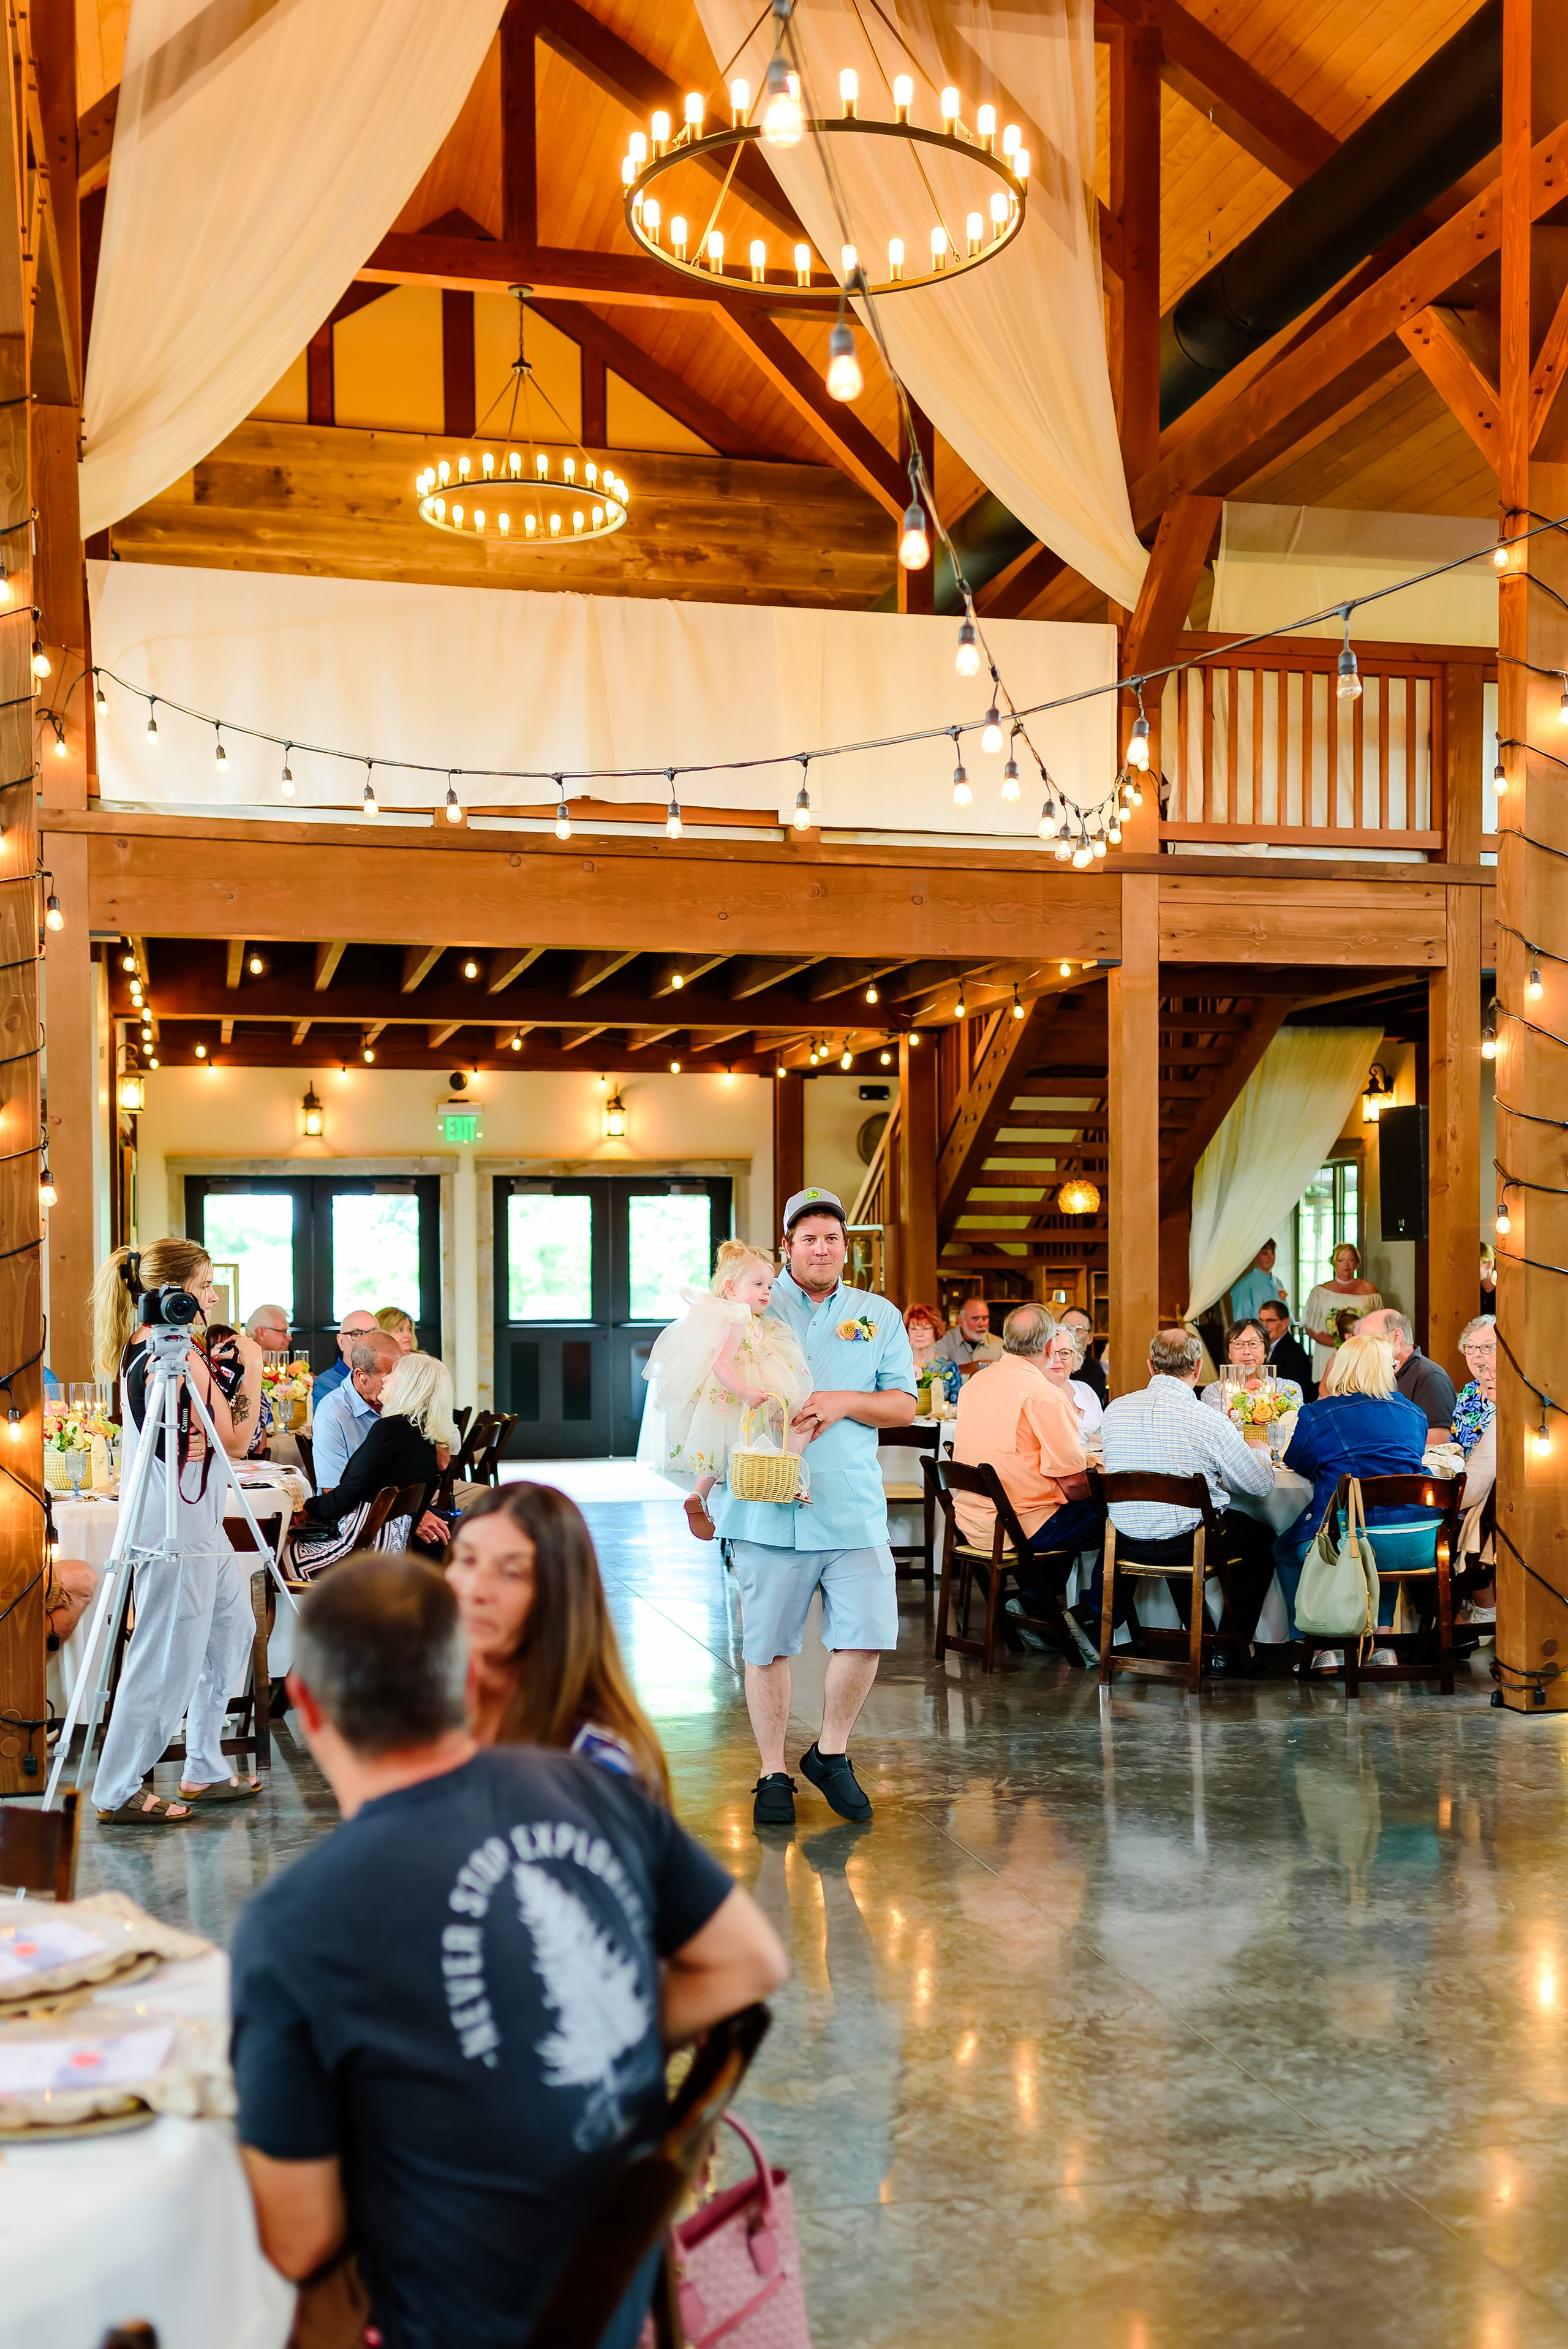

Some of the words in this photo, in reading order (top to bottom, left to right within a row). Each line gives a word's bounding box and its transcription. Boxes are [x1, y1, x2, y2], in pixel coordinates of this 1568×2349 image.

[445, 1116, 477, 1142] EXIT
[191, 1343, 203, 1355] 80D
[202, 1355, 217, 1373] EOS
[449, 1836, 510, 1918] STOP
[442, 1923, 499, 2060] NEVER
